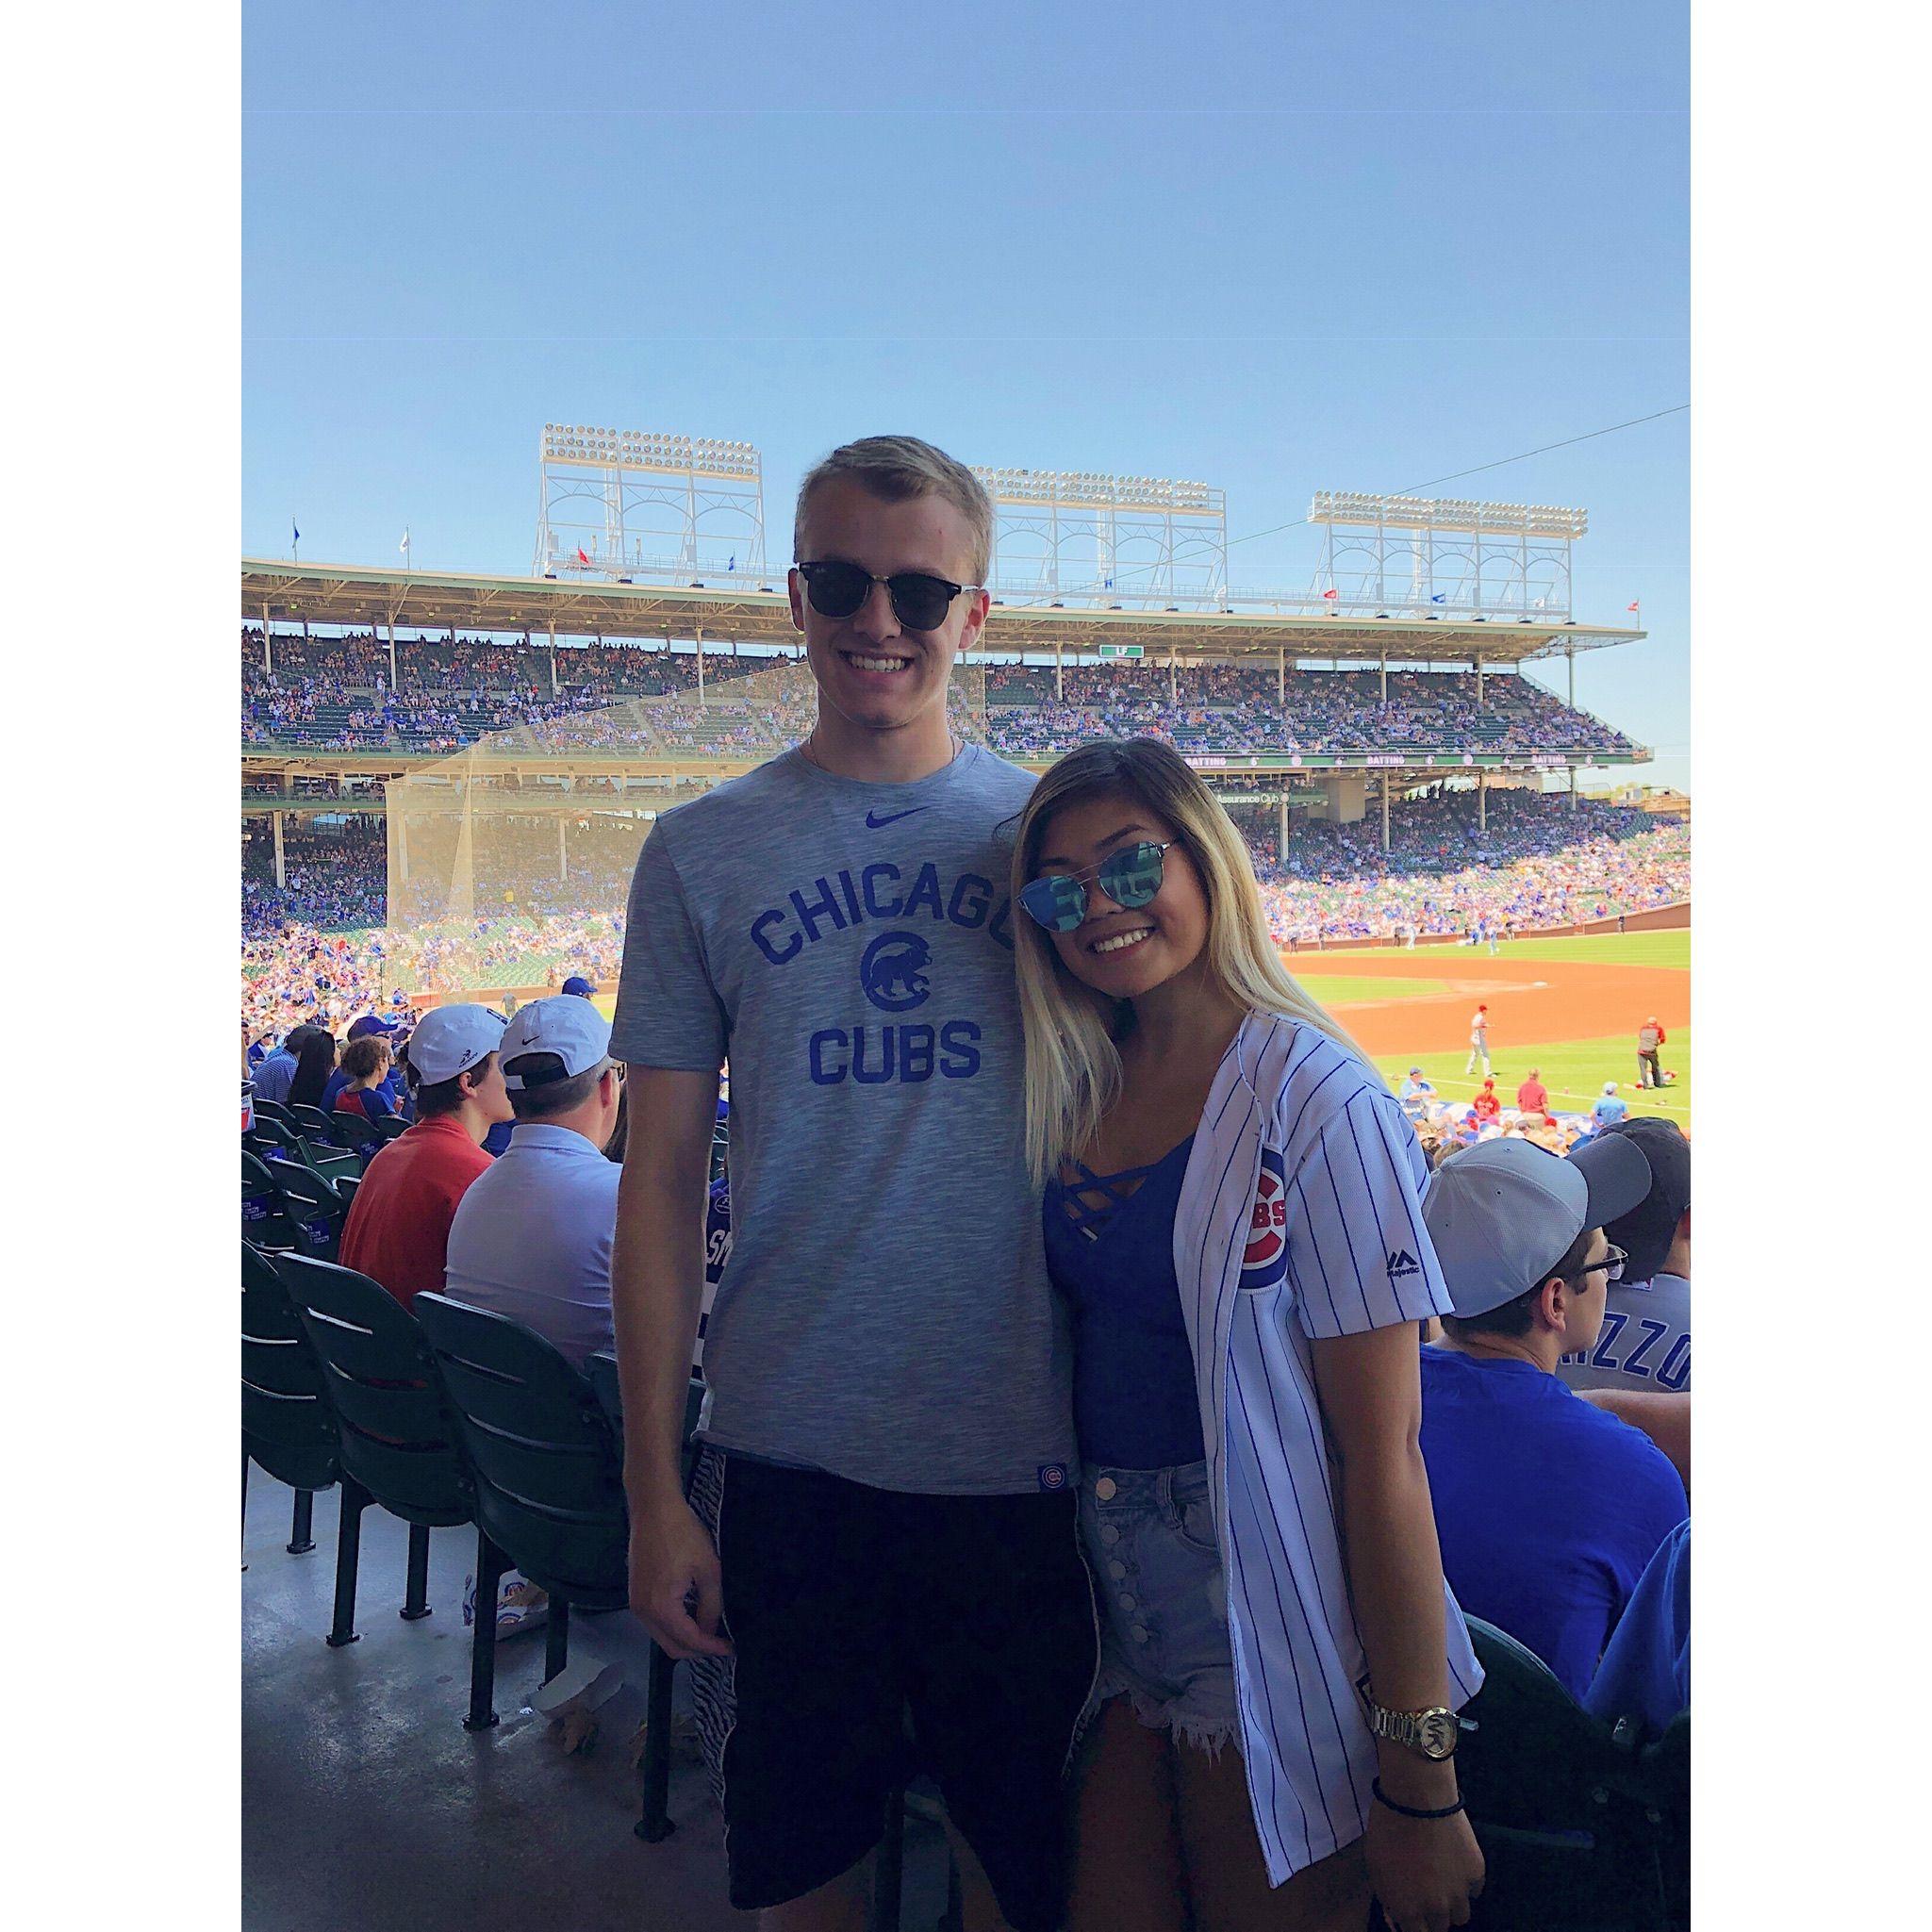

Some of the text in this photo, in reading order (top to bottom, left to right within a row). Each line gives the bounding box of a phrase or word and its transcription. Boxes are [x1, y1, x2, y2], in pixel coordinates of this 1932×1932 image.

[1367, 755, 1405, 766] BATTING
[1216, 793, 1280, 803] Assurance Club
[809, 1020, 982, 1084] CUBS
